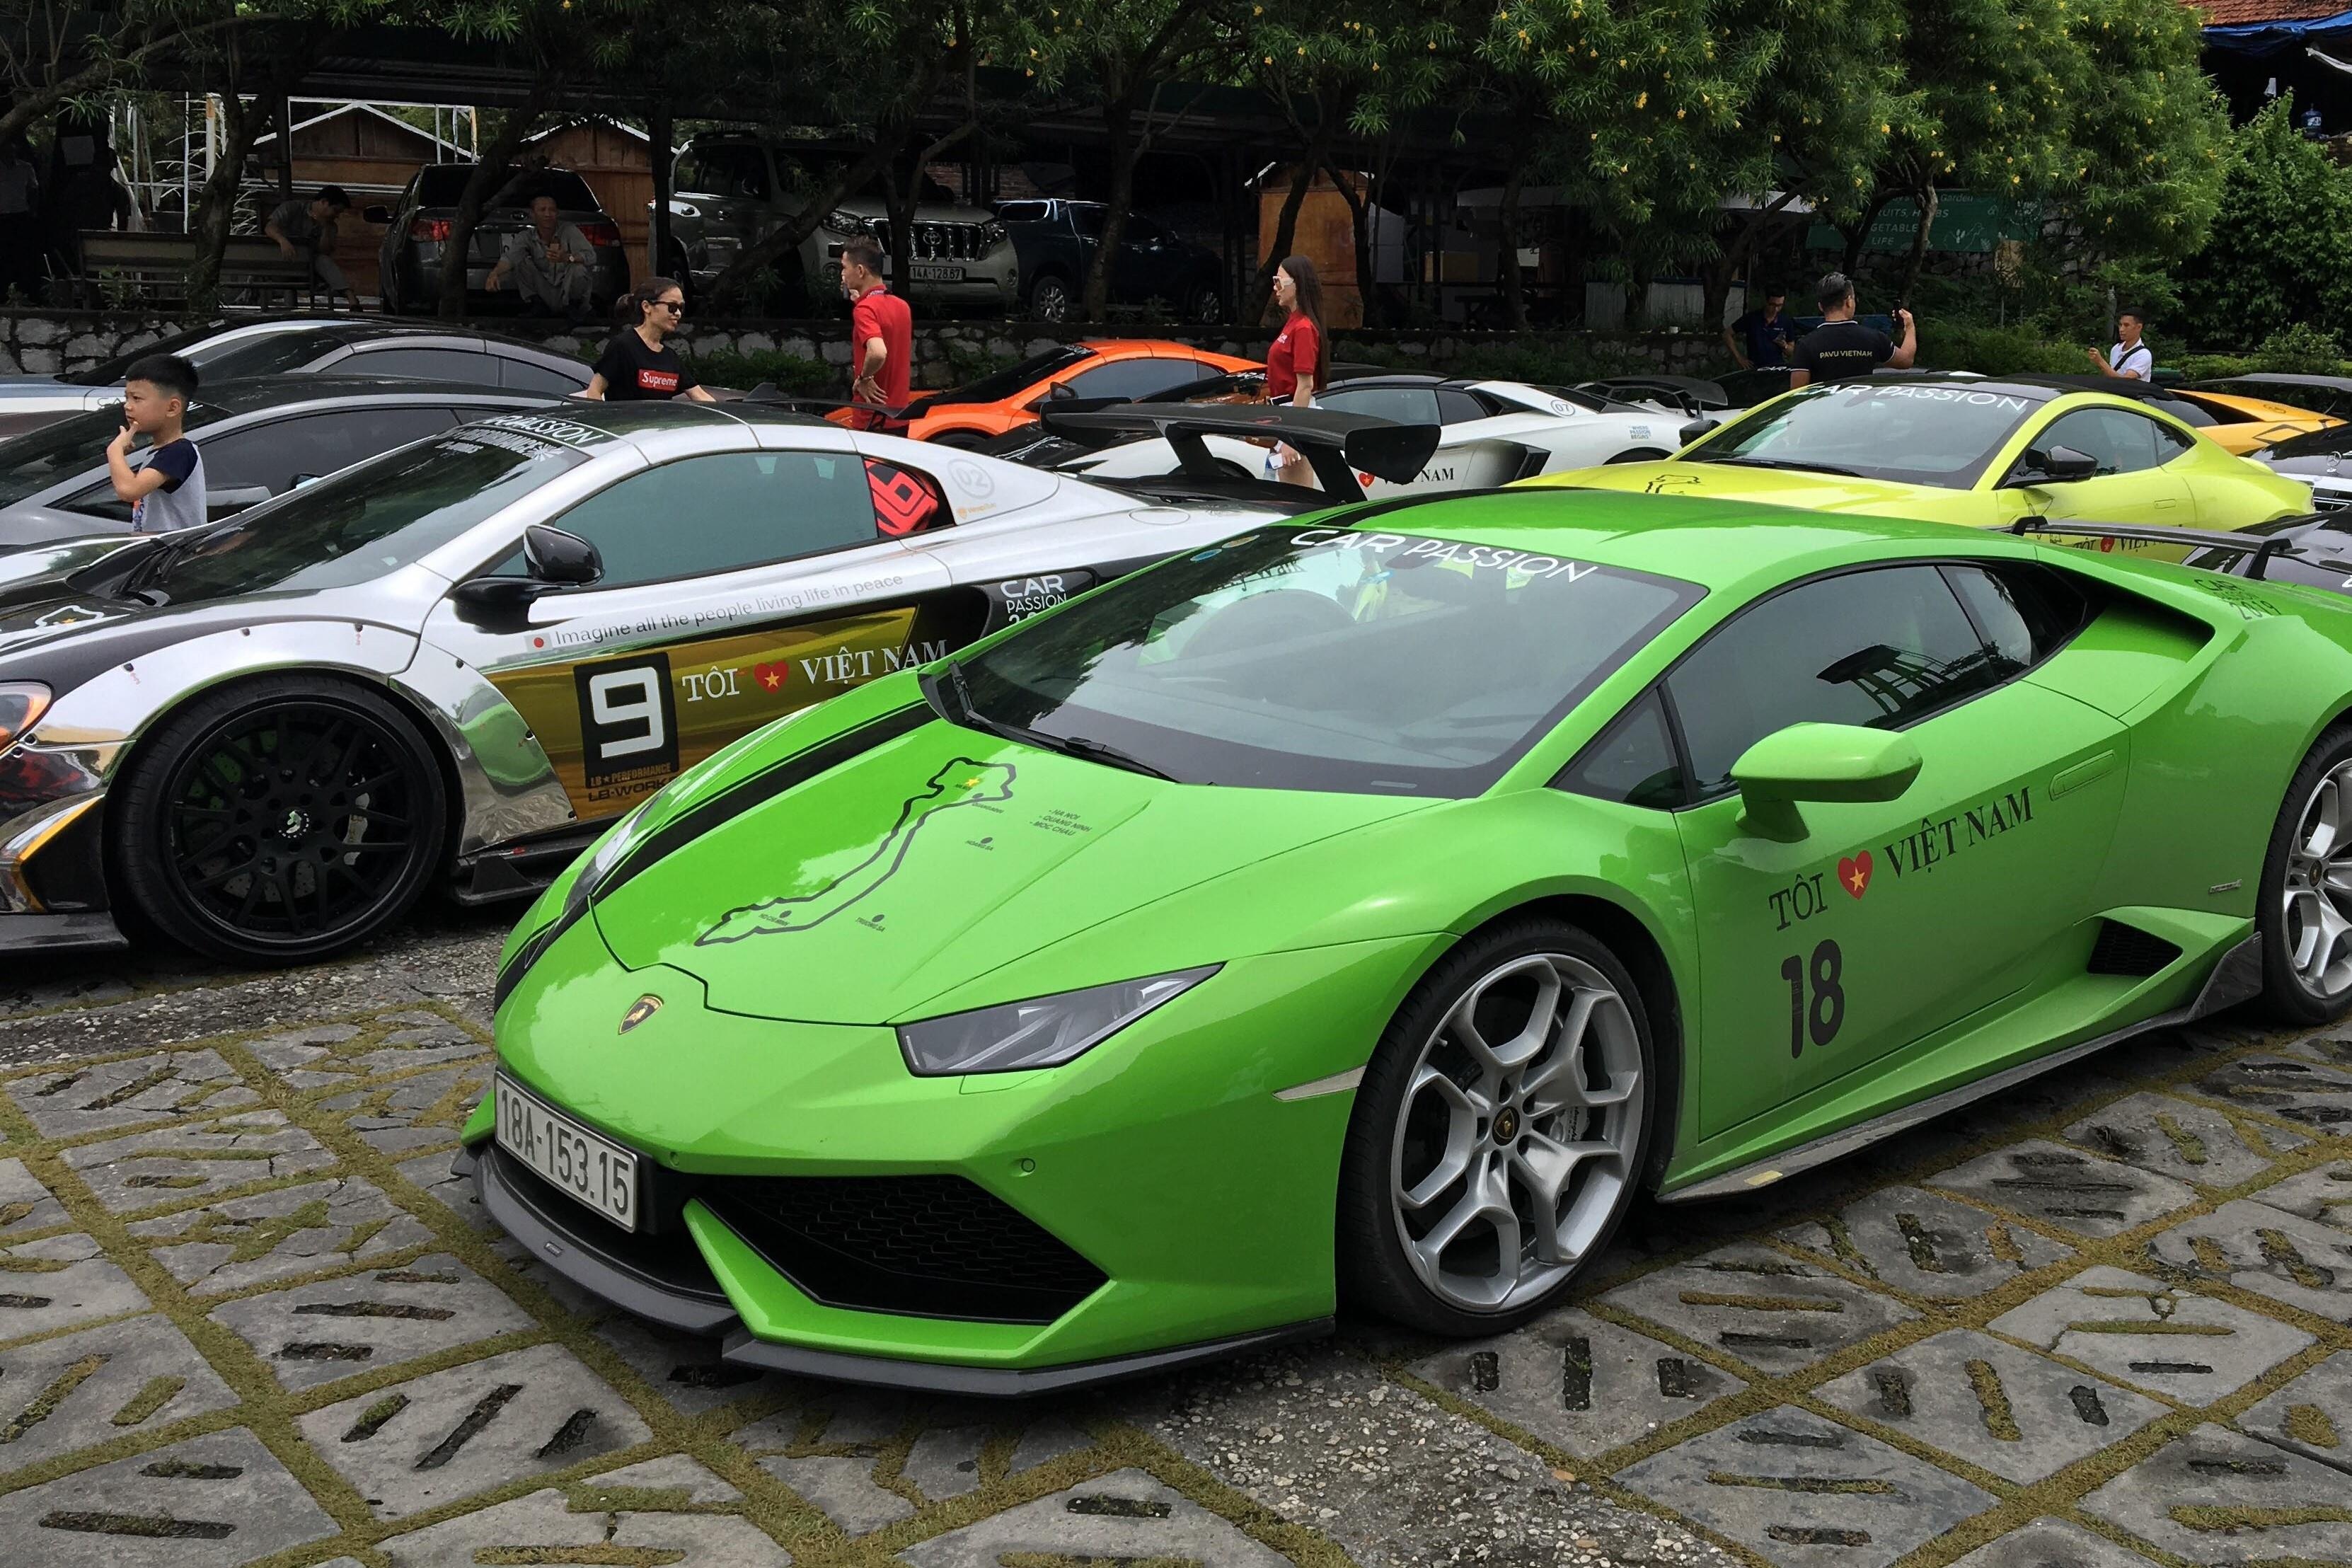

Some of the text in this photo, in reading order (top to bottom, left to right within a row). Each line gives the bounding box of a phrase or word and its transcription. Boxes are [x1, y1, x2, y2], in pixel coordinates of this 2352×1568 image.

[642, 371, 678, 388] Supreme
[1555, 403, 1570, 413] 07
[1793, 384, 2029, 411] CAR PASSION
[955, 468, 989, 488] 02
[1422, 468, 1455, 483] NAM
[1289, 529, 1598, 584] CAR PASSION
[1000, 574, 1066, 598] CAR
[555, 575, 904, 643] Imagine all the people living life in peace
[1005, 592, 1068, 614] PASSION
[681, 639, 947, 703] TÔI VIỆT NAM
[589, 667, 664, 759] 9
[588, 777, 672, 802] LB-WORK
[1042, 815, 1073, 826] QUANG
[1051, 826, 1077, 836] CHAU
[1768, 785, 2034, 932] TÔI VIỆT NAM
[1780, 938, 1845, 1059] 18
[501, 1088, 629, 1216] 18A-153.15
